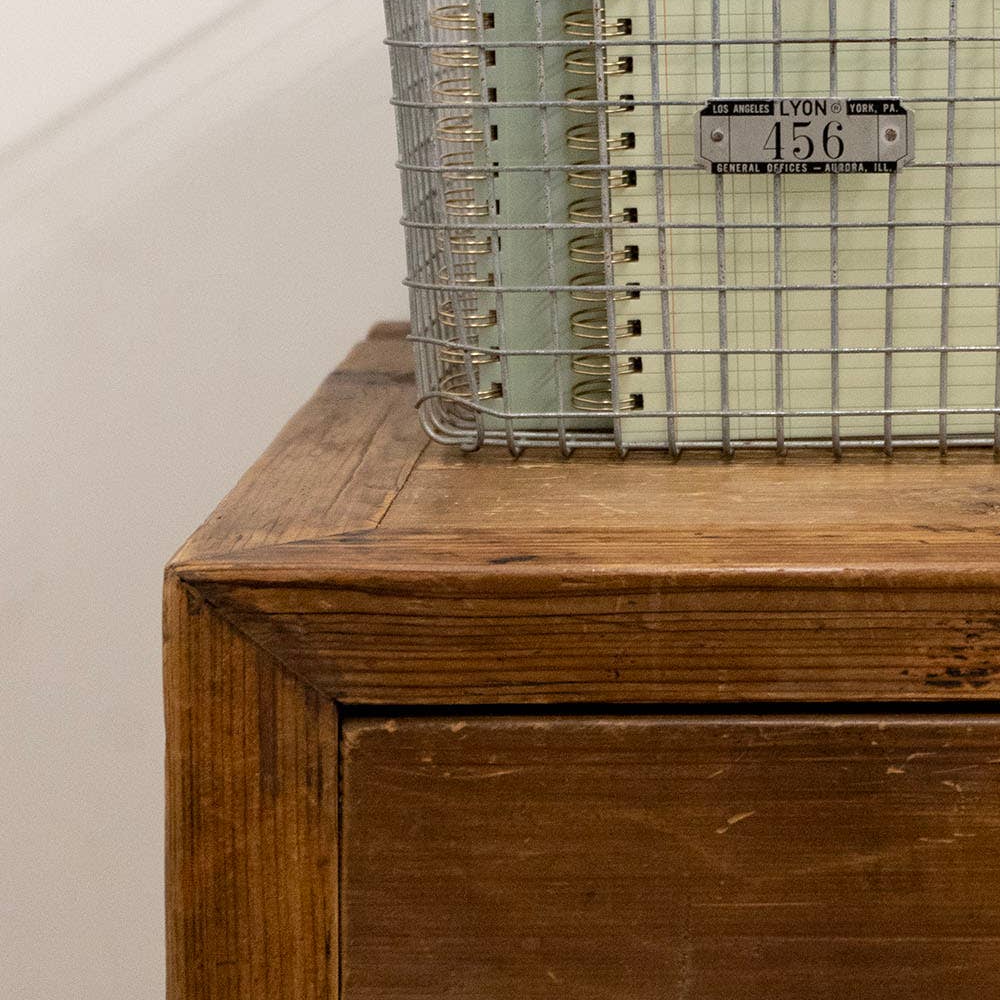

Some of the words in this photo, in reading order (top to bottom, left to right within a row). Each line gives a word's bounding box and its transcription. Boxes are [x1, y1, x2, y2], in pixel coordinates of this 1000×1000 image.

[712, 104, 729, 114] LOS
[733, 104, 770, 114] ANGELES
[850, 103, 878, 114] YORK,
[883, 103, 899, 113] PA.
[763, 120, 844, 160] 456
[716, 163, 760, 173] GENERAL
[767, 163, 808, 173] OFFICES
[824, 163, 868, 173] AURORA,
[874, 162, 892, 172] ILL.
